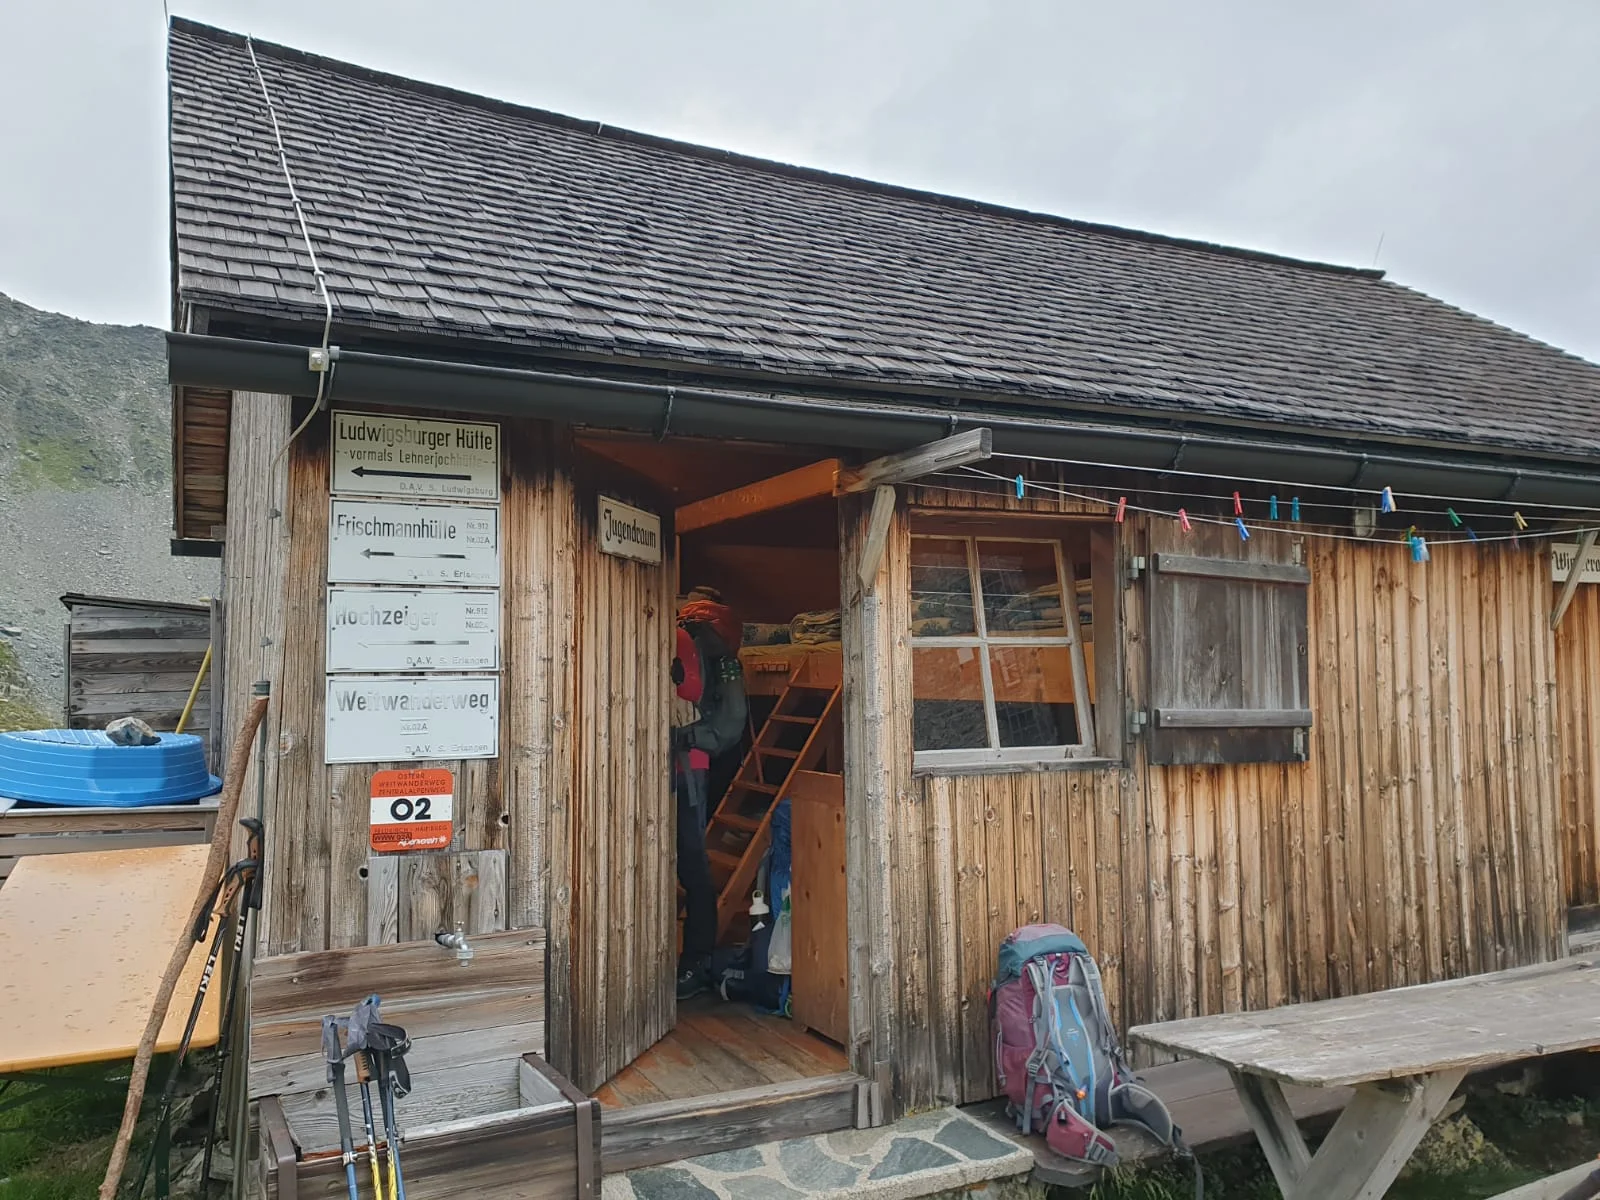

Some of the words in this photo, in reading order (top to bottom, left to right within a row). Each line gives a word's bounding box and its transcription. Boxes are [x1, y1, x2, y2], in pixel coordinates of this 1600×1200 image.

[340, 420, 451, 450] Ludwigsburger
[456, 428, 493, 450] Hütte
[442, 485, 494, 497] Ludwigsburg
[604, 508, 656, 548] Jugendraum
[335, 605, 438, 631] Hochzeiger
[406, 656, 432, 665] D.A.V.
[336, 690, 489, 714] Weitwanderweg
[234, 915, 245, 951] LEKI
[200, 955, 216, 992] LEKI
